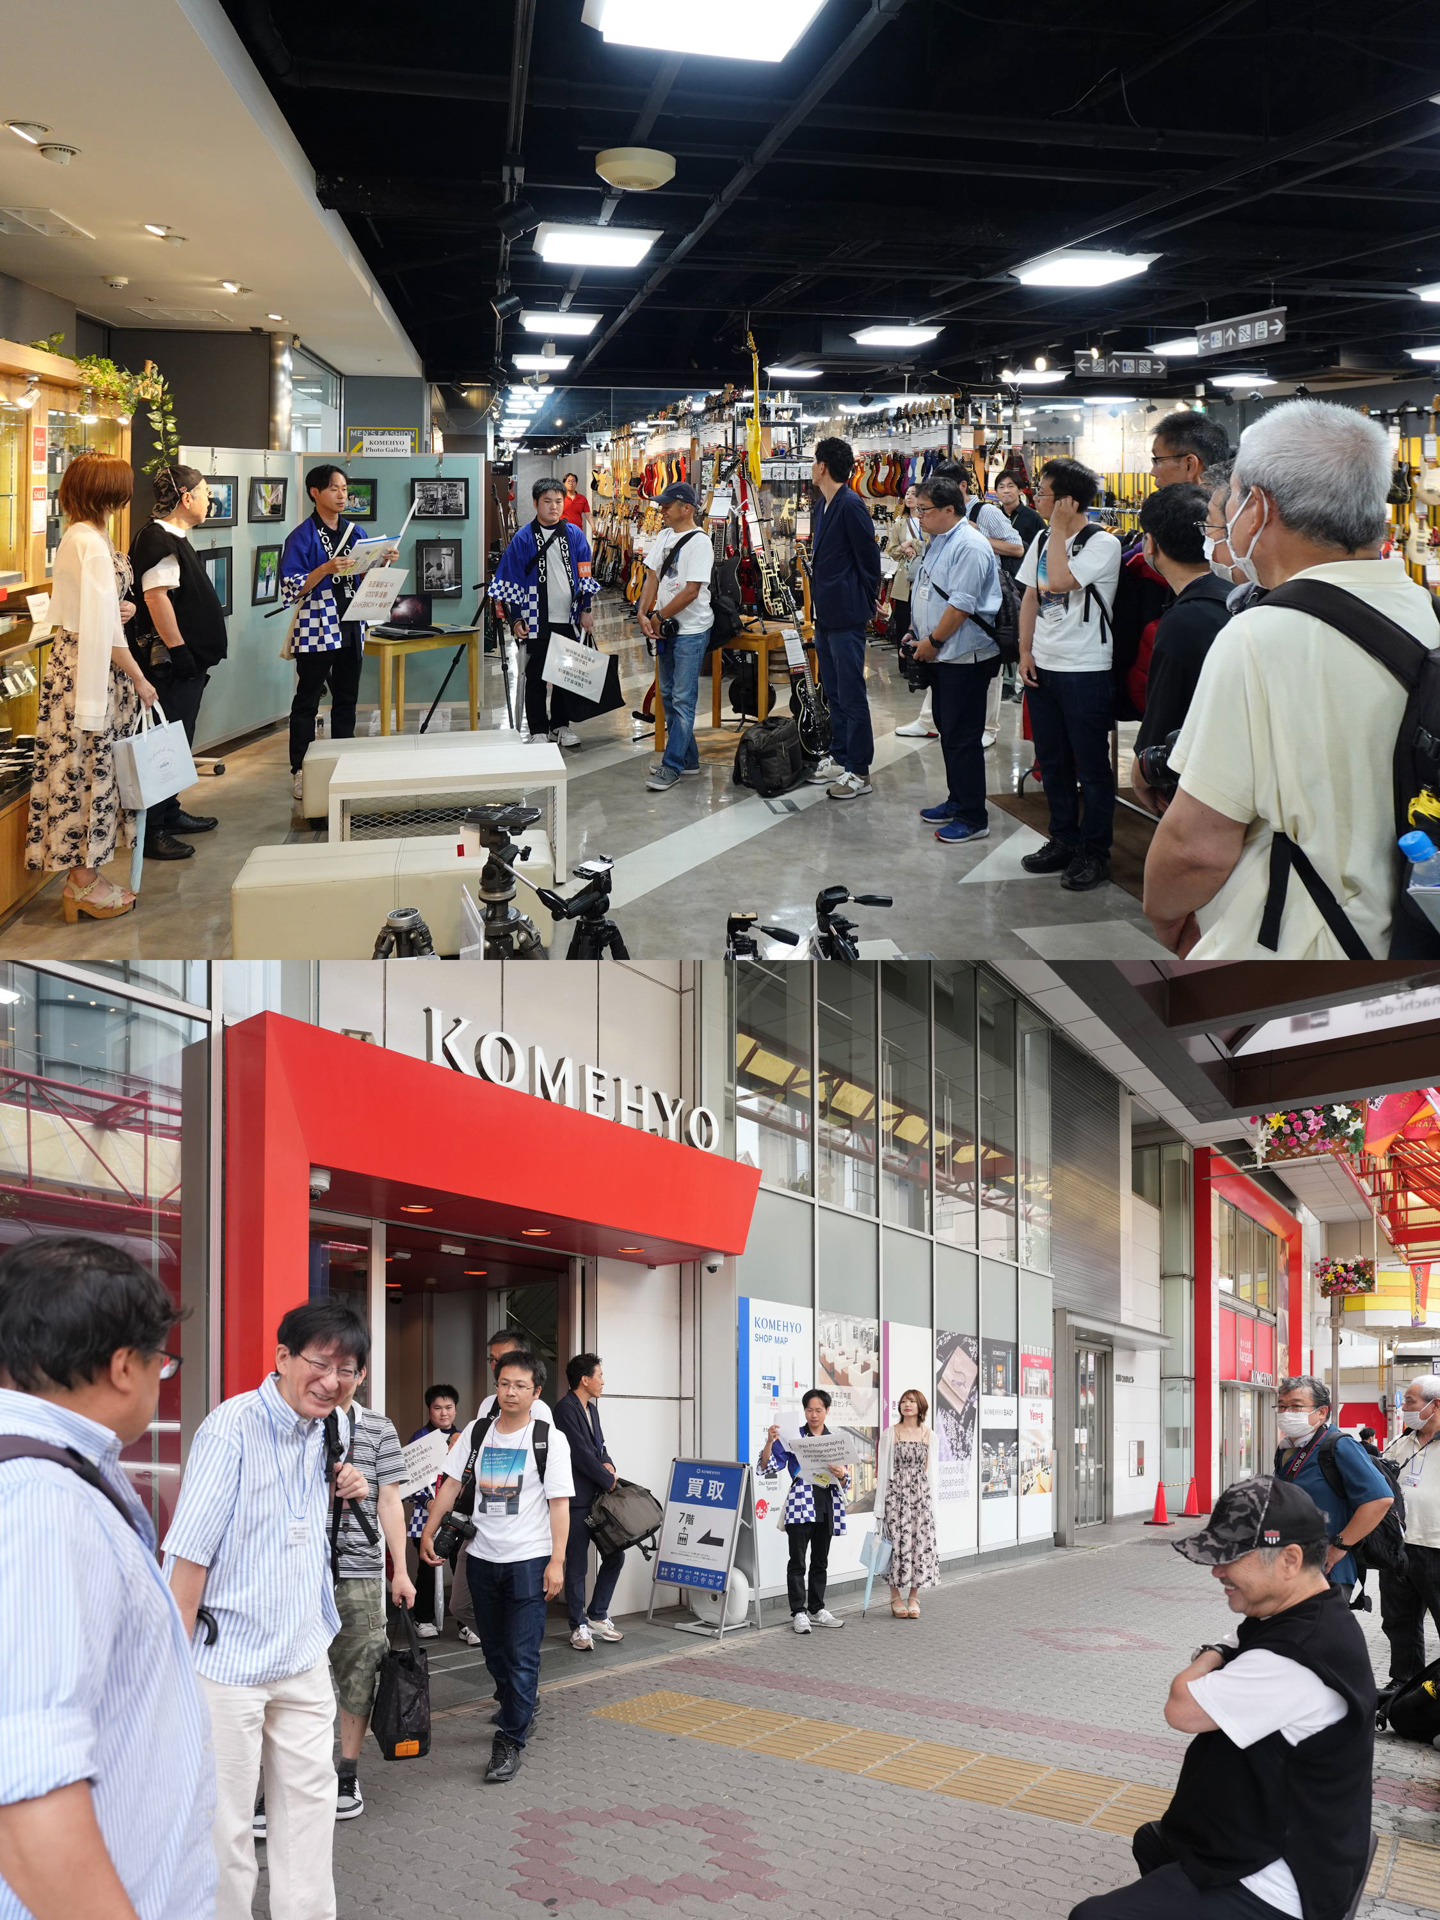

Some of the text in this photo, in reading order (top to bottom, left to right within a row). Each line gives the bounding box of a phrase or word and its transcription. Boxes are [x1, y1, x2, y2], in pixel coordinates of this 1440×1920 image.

[378, 430, 415, 438] FASHION
[560, 536, 575, 587] KOMEHYO
[423, 1006, 720, 1152] KOMEHYO
[754, 1316, 802, 1334] KOMEHYO
[754, 1333, 789, 1345] SHOP MAP
[467, 1448, 478, 1469] SONY
[1291, 1459, 1301, 1472] EOS
[939, 1465, 959, 1475] Kimono
[685, 1477, 726, 1501] 買取
[939, 1478, 965, 1489] Japanese
[938, 1490, 970, 1501] accessories
[678, 1511, 695, 1526] 7階
